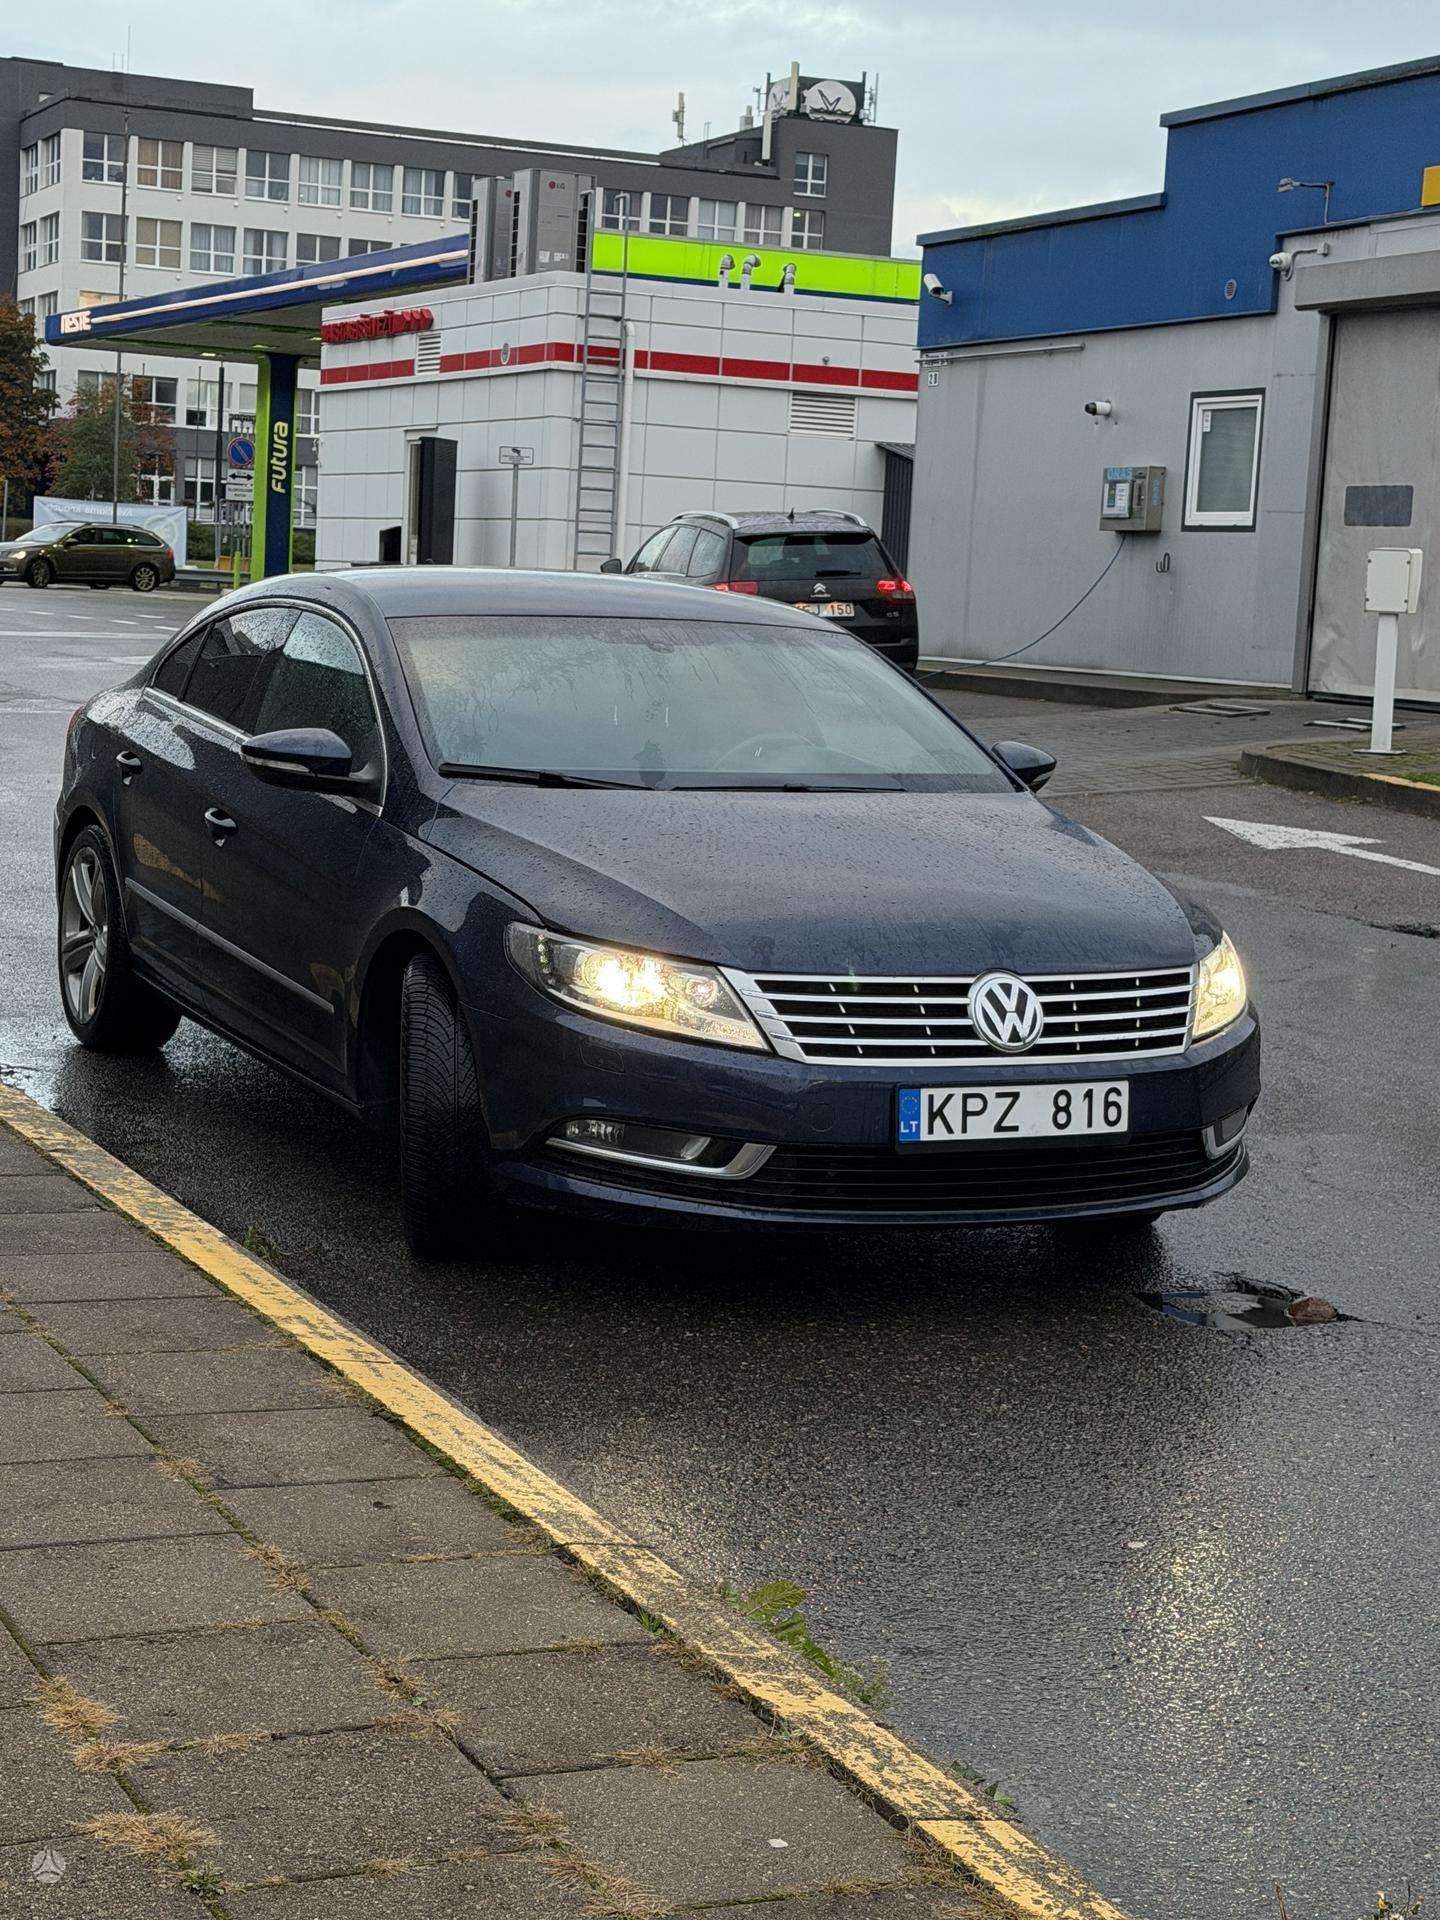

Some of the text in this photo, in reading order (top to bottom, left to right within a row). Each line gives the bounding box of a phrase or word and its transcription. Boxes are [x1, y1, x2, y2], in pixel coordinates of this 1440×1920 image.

[60, 310, 92, 335] NESTE
[829, 602, 853, 616] 150
[927, 1086, 1123, 1135] KPZ 816
[900, 1120, 919, 1134] LT
